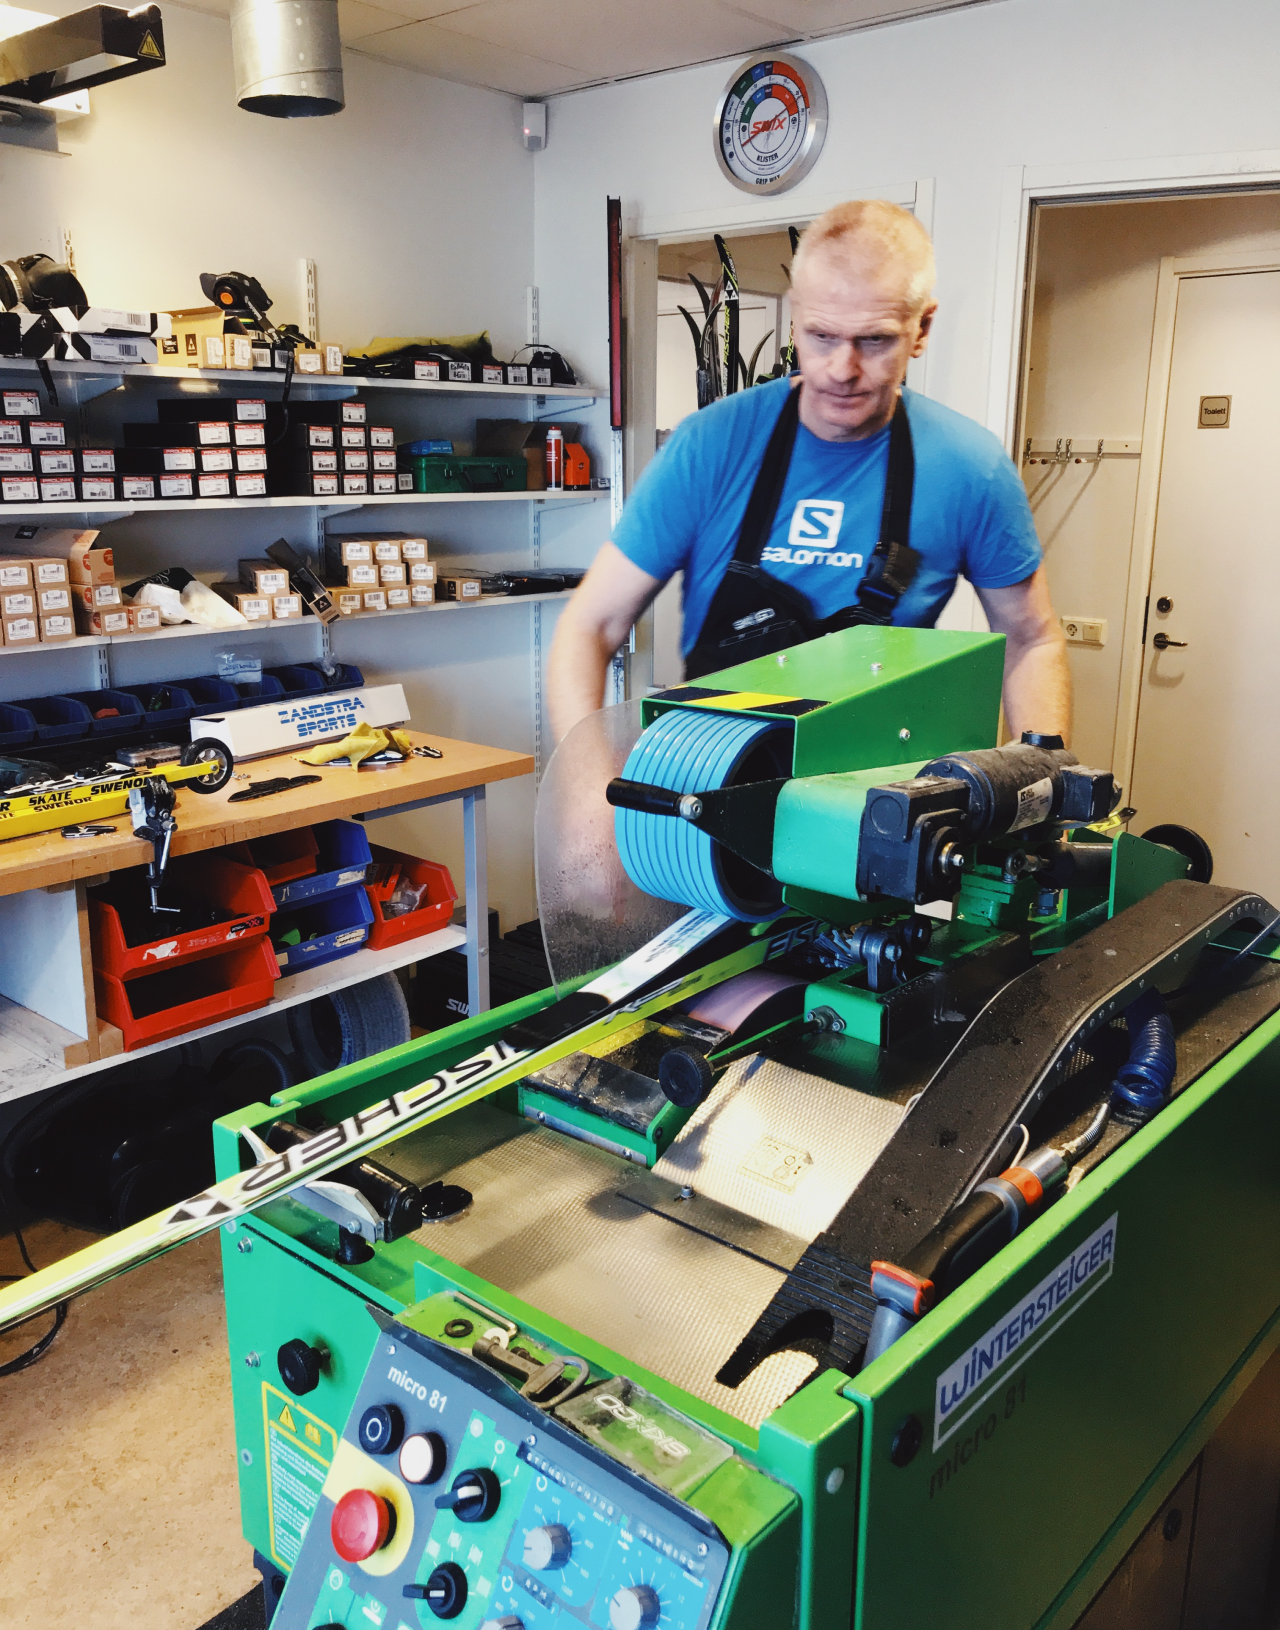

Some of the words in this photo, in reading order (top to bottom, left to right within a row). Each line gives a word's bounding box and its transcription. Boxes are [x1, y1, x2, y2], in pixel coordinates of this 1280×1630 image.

[756, 152, 779, 163] KLISTER
[755, 177, 769, 185] GRIP
[723, 304, 731, 366] FISCHER
[1203, 407, 1226, 415] Toalett
[278, 697, 365, 724] ZANDSTRA
[296, 713, 357, 737] SPORTS
[28, 790, 73, 807] SKATE
[33, 796, 93, 813] SWENOR
[446, 998, 470, 1016] SW
[241, 1042, 508, 1192] ISCHER
[939, 1228, 1114, 1415] WINTERSTEIGER
[387, 1366, 427, 1401] micro
[429, 1389, 448, 1413] 81
[928, 1412, 998, 1499] micro
[1003, 1374, 1028, 1420] 81
